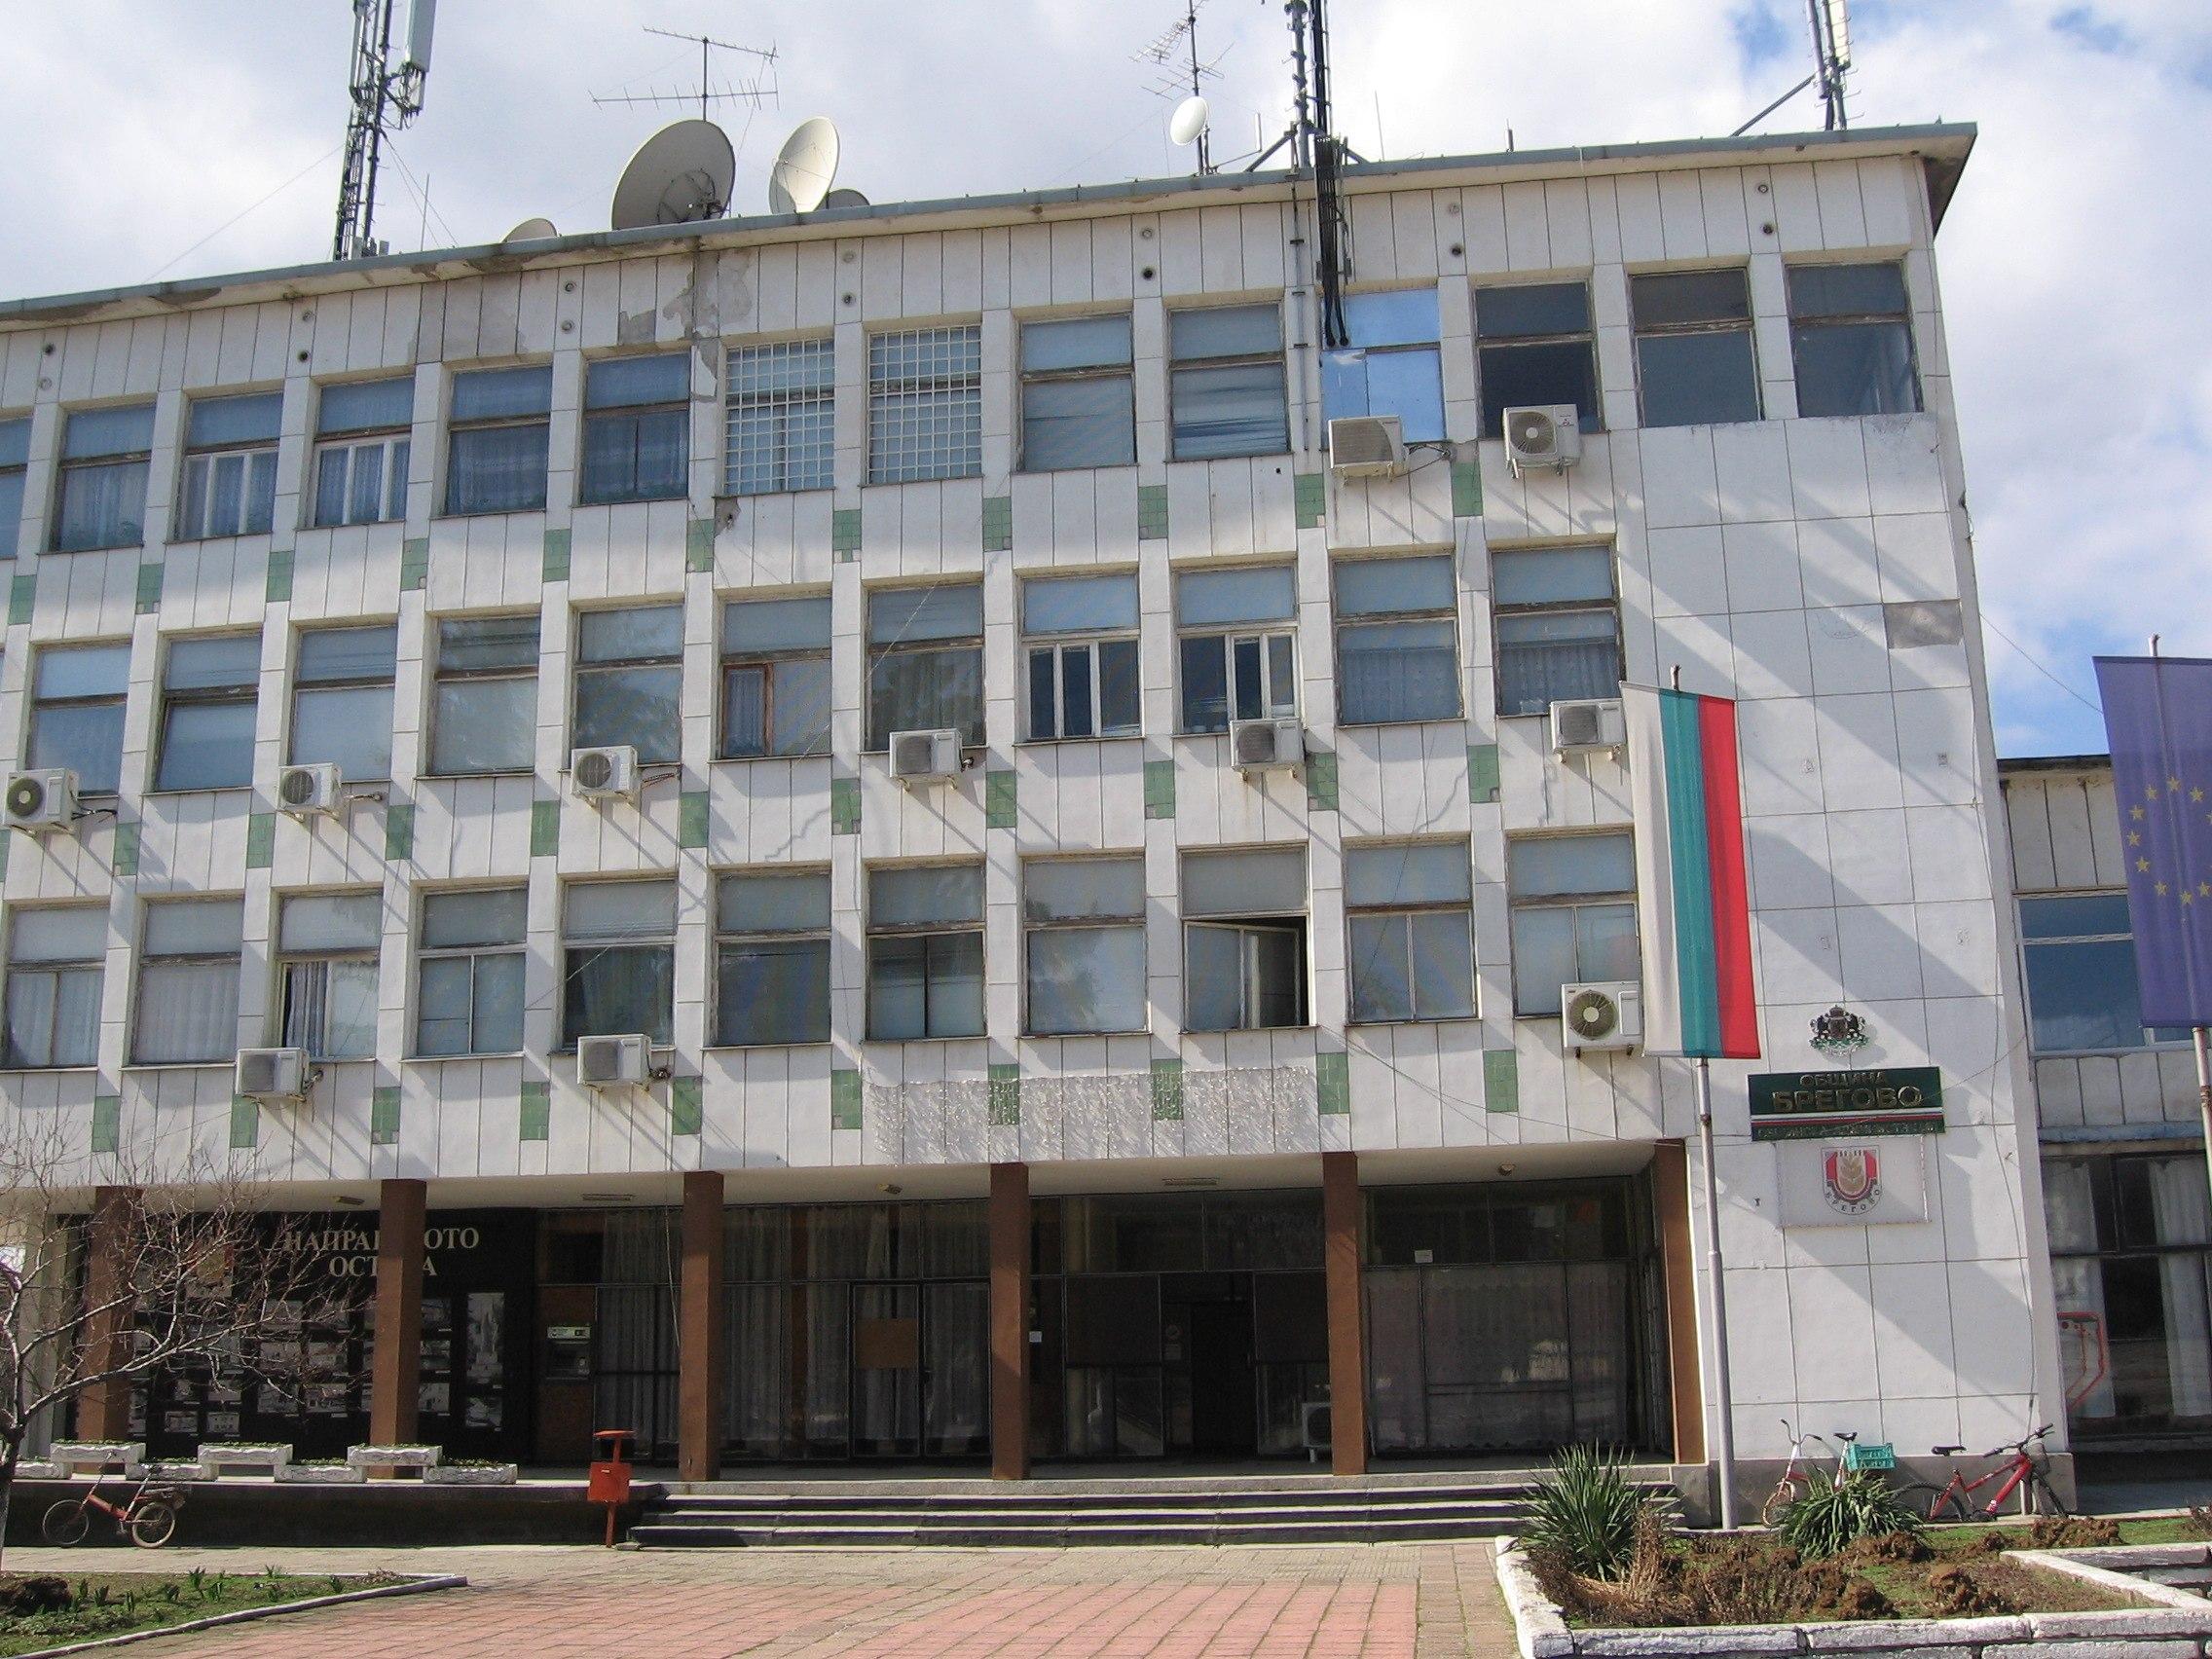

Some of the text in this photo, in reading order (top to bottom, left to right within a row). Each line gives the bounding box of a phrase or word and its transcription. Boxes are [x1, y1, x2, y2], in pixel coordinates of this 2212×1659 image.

[1800, 1071, 1886, 1088] ОБЩИНА
[1772, 1086, 1923, 1113] БРЕГОВО
[285, 1227, 480, 1251] НАПРАОТО
[328, 1255, 438, 1277] ОСТА
